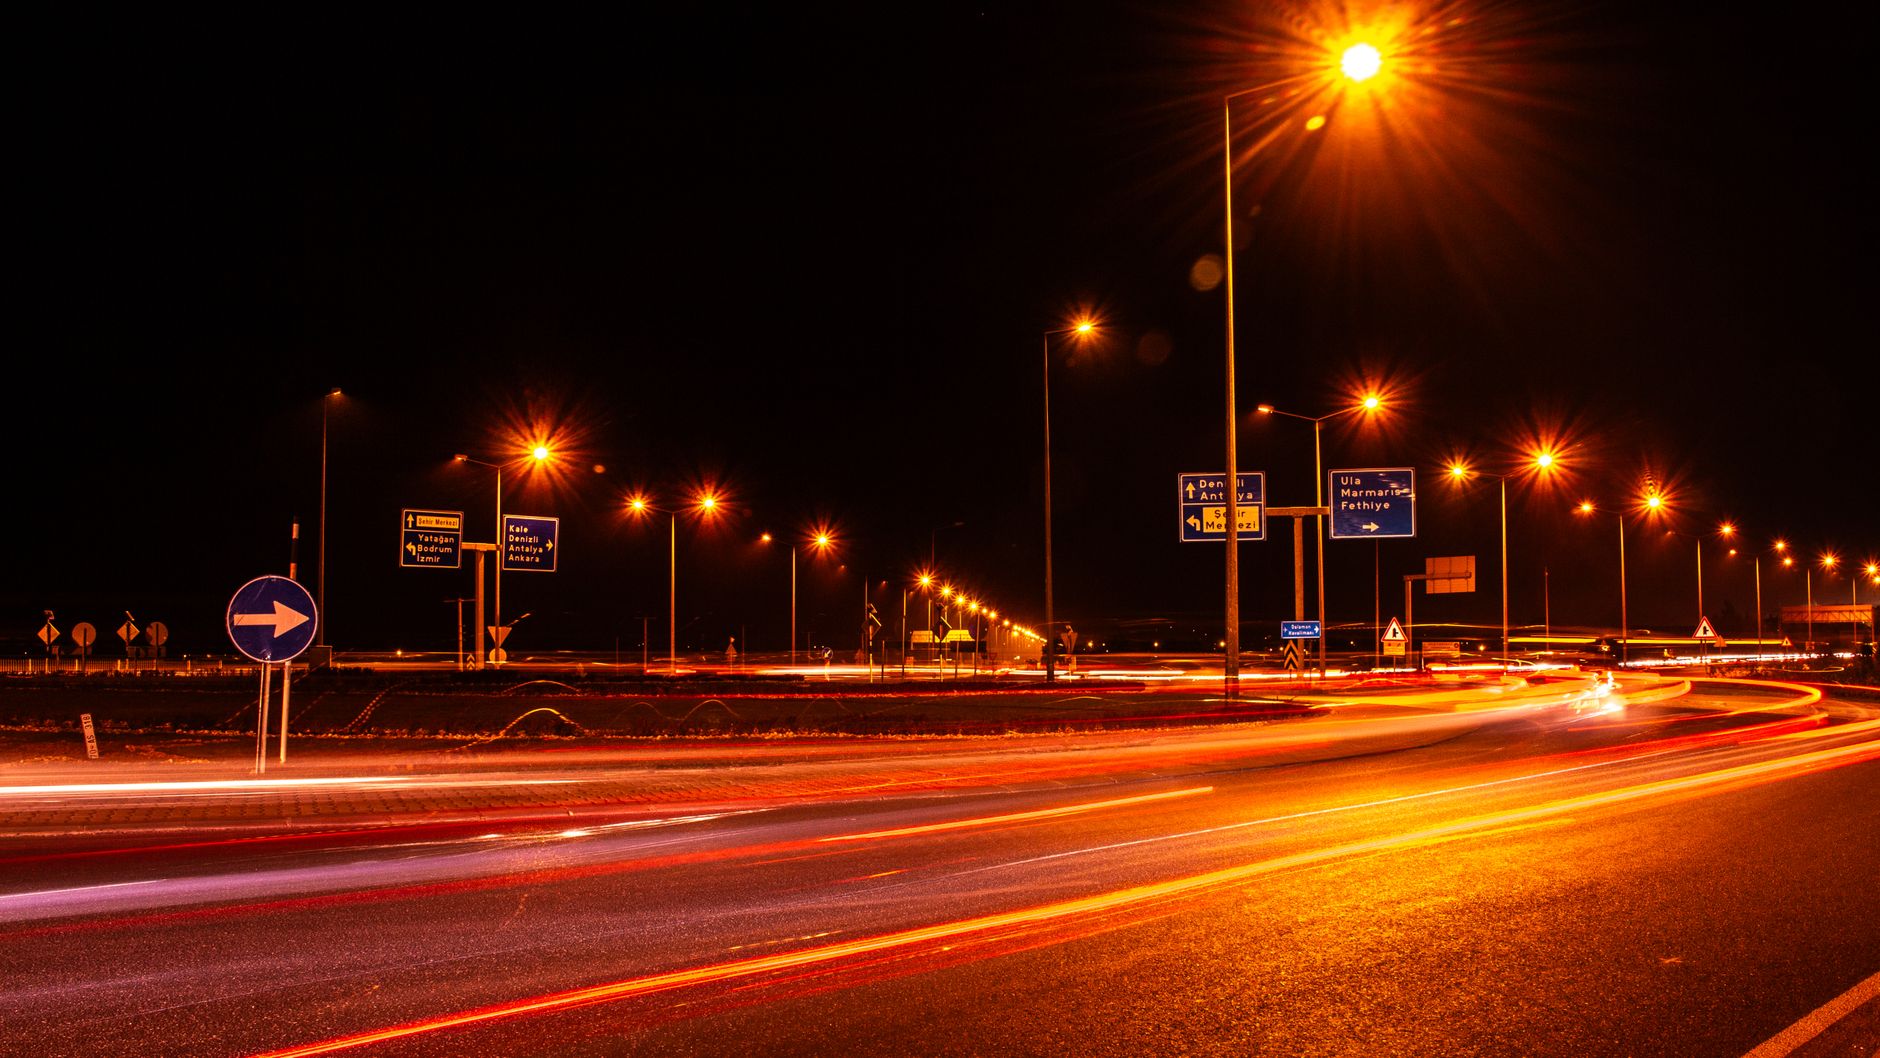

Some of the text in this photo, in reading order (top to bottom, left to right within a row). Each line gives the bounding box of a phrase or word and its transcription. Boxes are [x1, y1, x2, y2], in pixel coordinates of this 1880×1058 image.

[1200, 479, 1244, 488] Denli
[1341, 476, 1361, 485] Ula
[1200, 491, 1253, 501] Antya
[1341, 488, 1401, 497] Marmaris
[1341, 501, 1390, 511] Fethiye
[509, 525, 528, 533] Kale
[418, 534, 454, 544] Yatağan
[509, 535, 539, 543] Denizli
[417, 544, 453, 553] Bodrum
[509, 545, 543, 554] Antalya
[509, 554, 540, 562] Ankara
